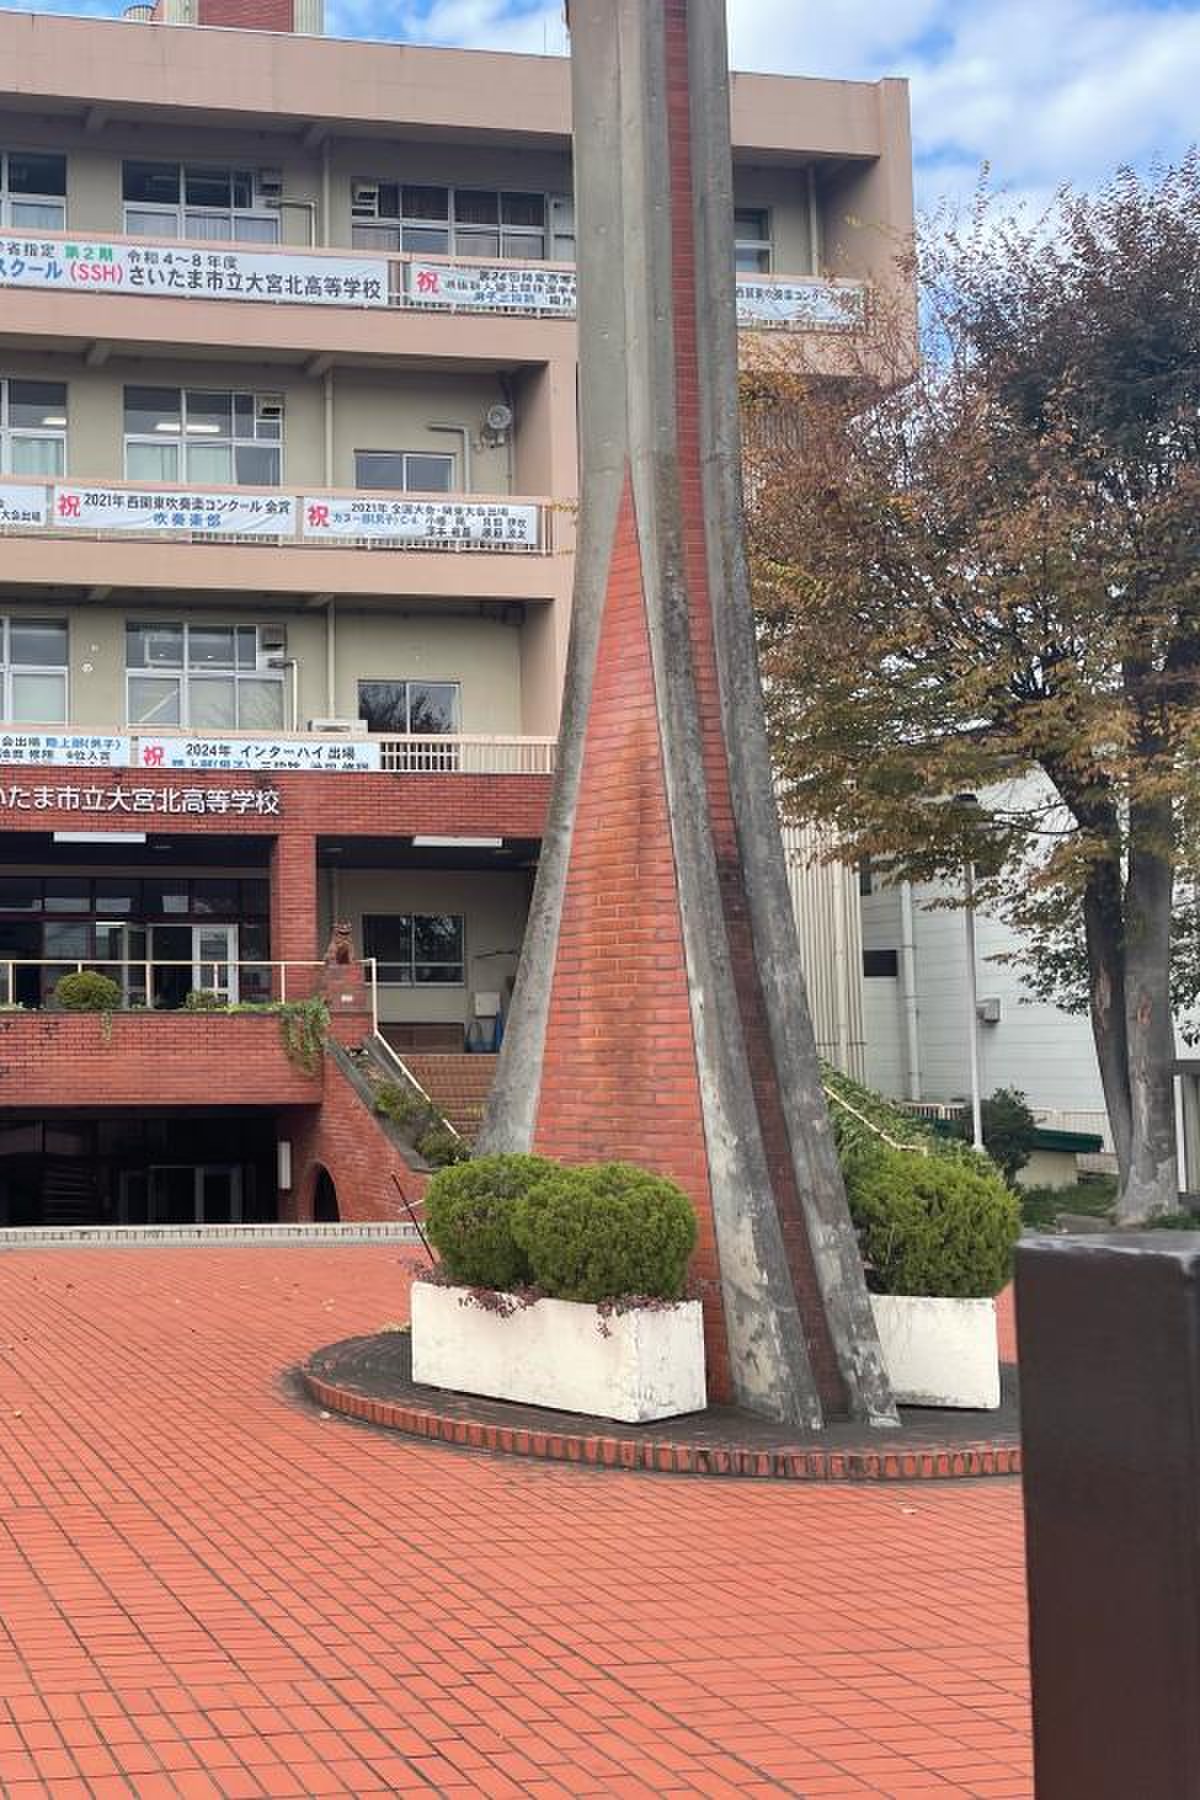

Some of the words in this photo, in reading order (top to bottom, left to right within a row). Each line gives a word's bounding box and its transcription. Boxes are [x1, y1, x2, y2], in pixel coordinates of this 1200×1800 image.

[416, 271, 439, 294] 祝
[58, 494, 80, 518] 祝
[307, 501, 329, 527] 祝
[143, 746, 164, 767] 祝
